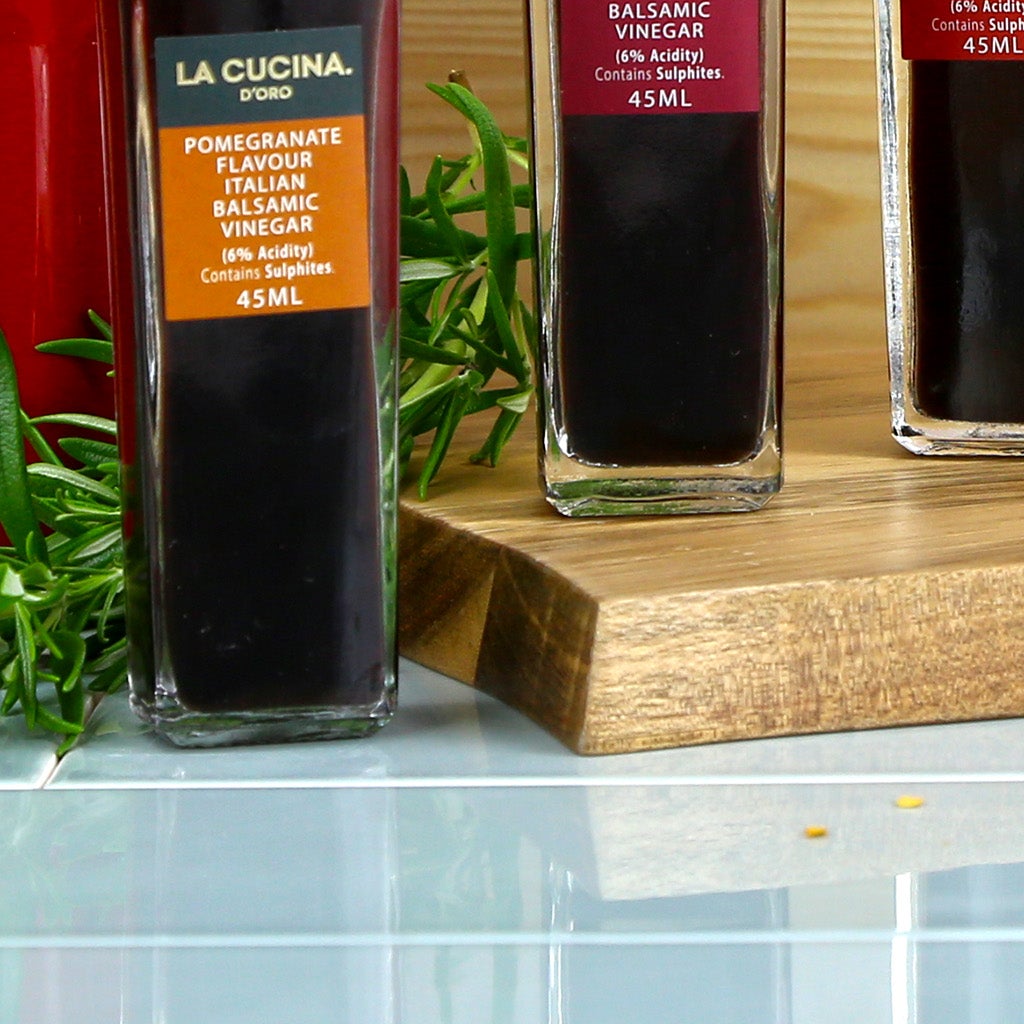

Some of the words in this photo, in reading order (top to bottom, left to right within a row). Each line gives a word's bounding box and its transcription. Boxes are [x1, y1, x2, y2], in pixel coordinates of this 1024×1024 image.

[608, 2, 710, 19] BALSAMIC
[950, 0, 977, 14] (6%
[615, 23, 704, 39] VINEGAR
[932, 18, 985, 32] Contains
[963, 36, 1023, 54] 45ML
[615, 49, 644, 65] (6%
[650, 48, 704, 64] Acidity)
[176, 60, 215, 86] LA
[221, 52, 353, 84] CUCINA.
[595, 67, 651, 81] Contains
[656, 65, 724, 82] Sulphites.
[628, 89, 692, 107] 45ML
[184, 127, 341, 154] POMEGRANATE
[216, 152, 312, 173] FLAVOUR
[225, 174, 305, 195] ITALIAN
[213, 194, 319, 218] BALSAMIC
[220, 216, 313, 238] VINEGAR
[222, 248, 253, 265] (6%
[258, 242, 314, 261] Acidity)
[201, 267, 260, 283] Contains
[264, 262, 334, 280] Sulphites.
[236, 286, 303, 309] 45ML
